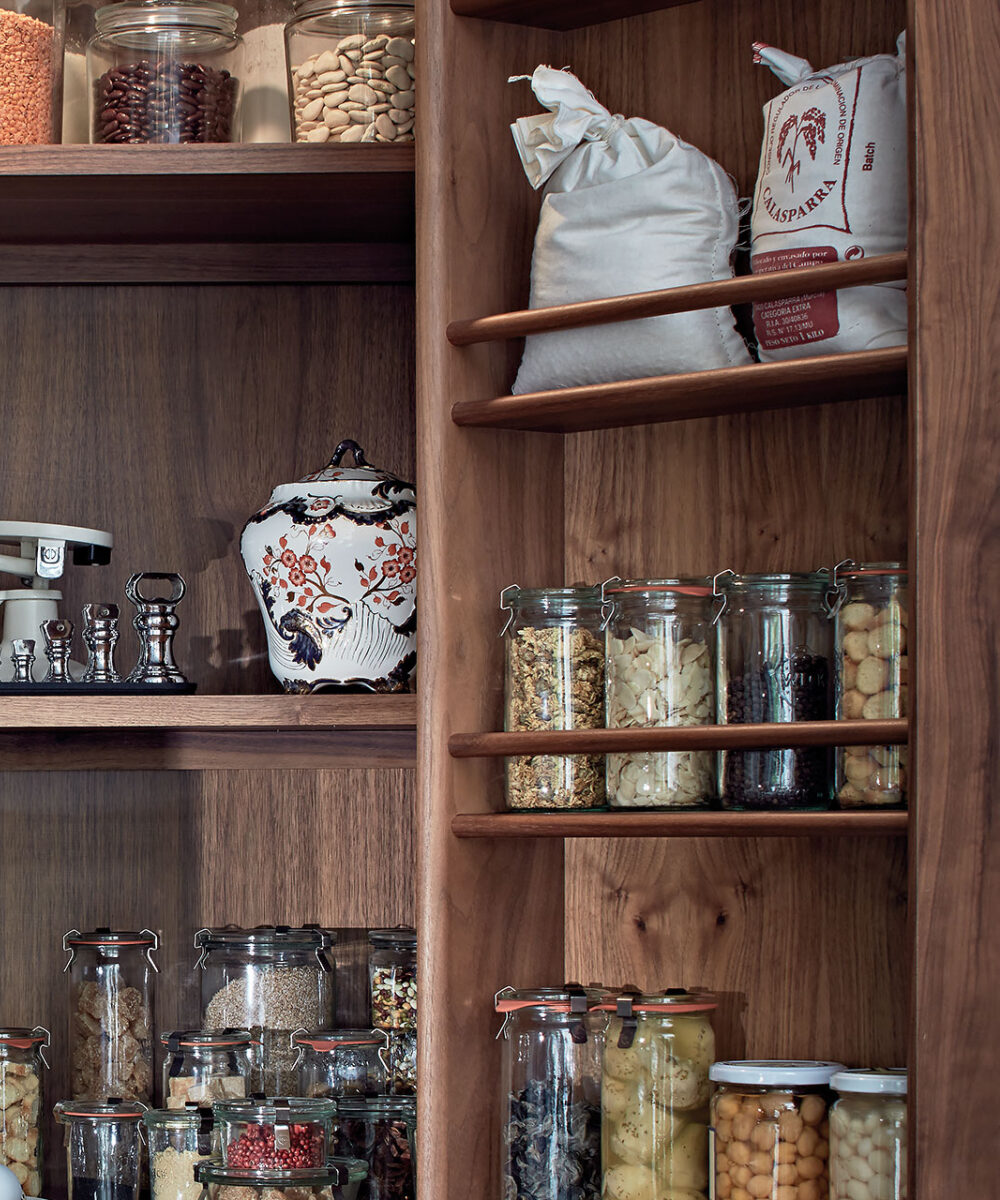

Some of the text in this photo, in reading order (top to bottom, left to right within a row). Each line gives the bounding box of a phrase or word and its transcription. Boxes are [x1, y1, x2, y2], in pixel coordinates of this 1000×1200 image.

[832, 80, 847, 166] MINACION DE ORIGEN
[862, 142, 876, 171] Batch
[763, 179, 837, 223] CALASPARRA
[812, 251, 828, 259] por
[761, 302, 811, 320] CATEGORIA EXTRA
[807, 329, 825, 339] KILO
